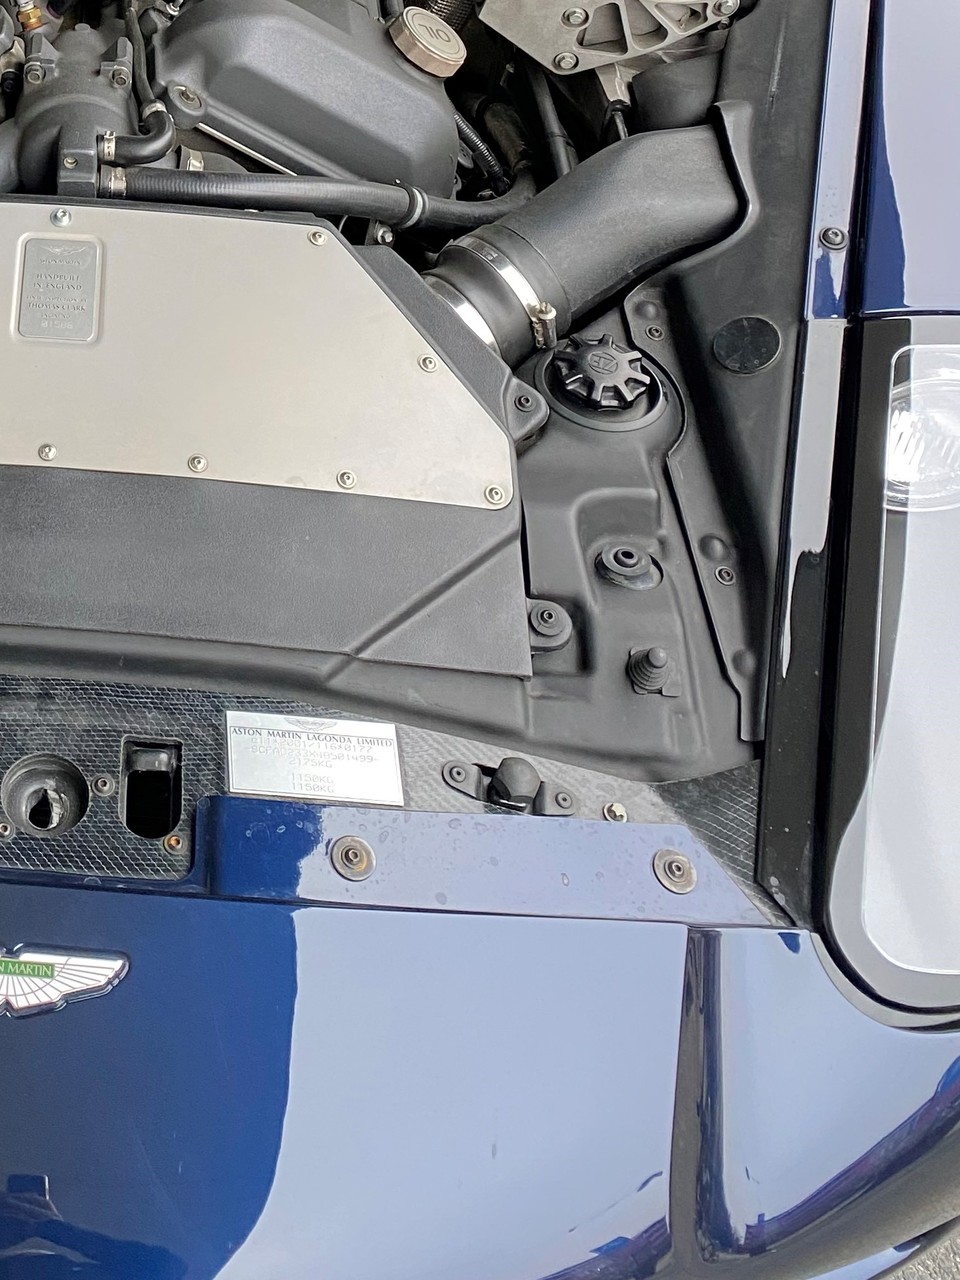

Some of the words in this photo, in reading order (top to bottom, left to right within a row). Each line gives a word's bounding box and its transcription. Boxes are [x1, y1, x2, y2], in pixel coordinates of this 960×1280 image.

[418, 23, 452, 43] OIL
[232, 727, 263, 737] ASTON
[267, 730, 302, 741] MARTIN
[307, 733, 353, 745] LAGONDA
[357, 738, 393, 748] LIMITED
[7, 963, 53, 977] MARTIN
